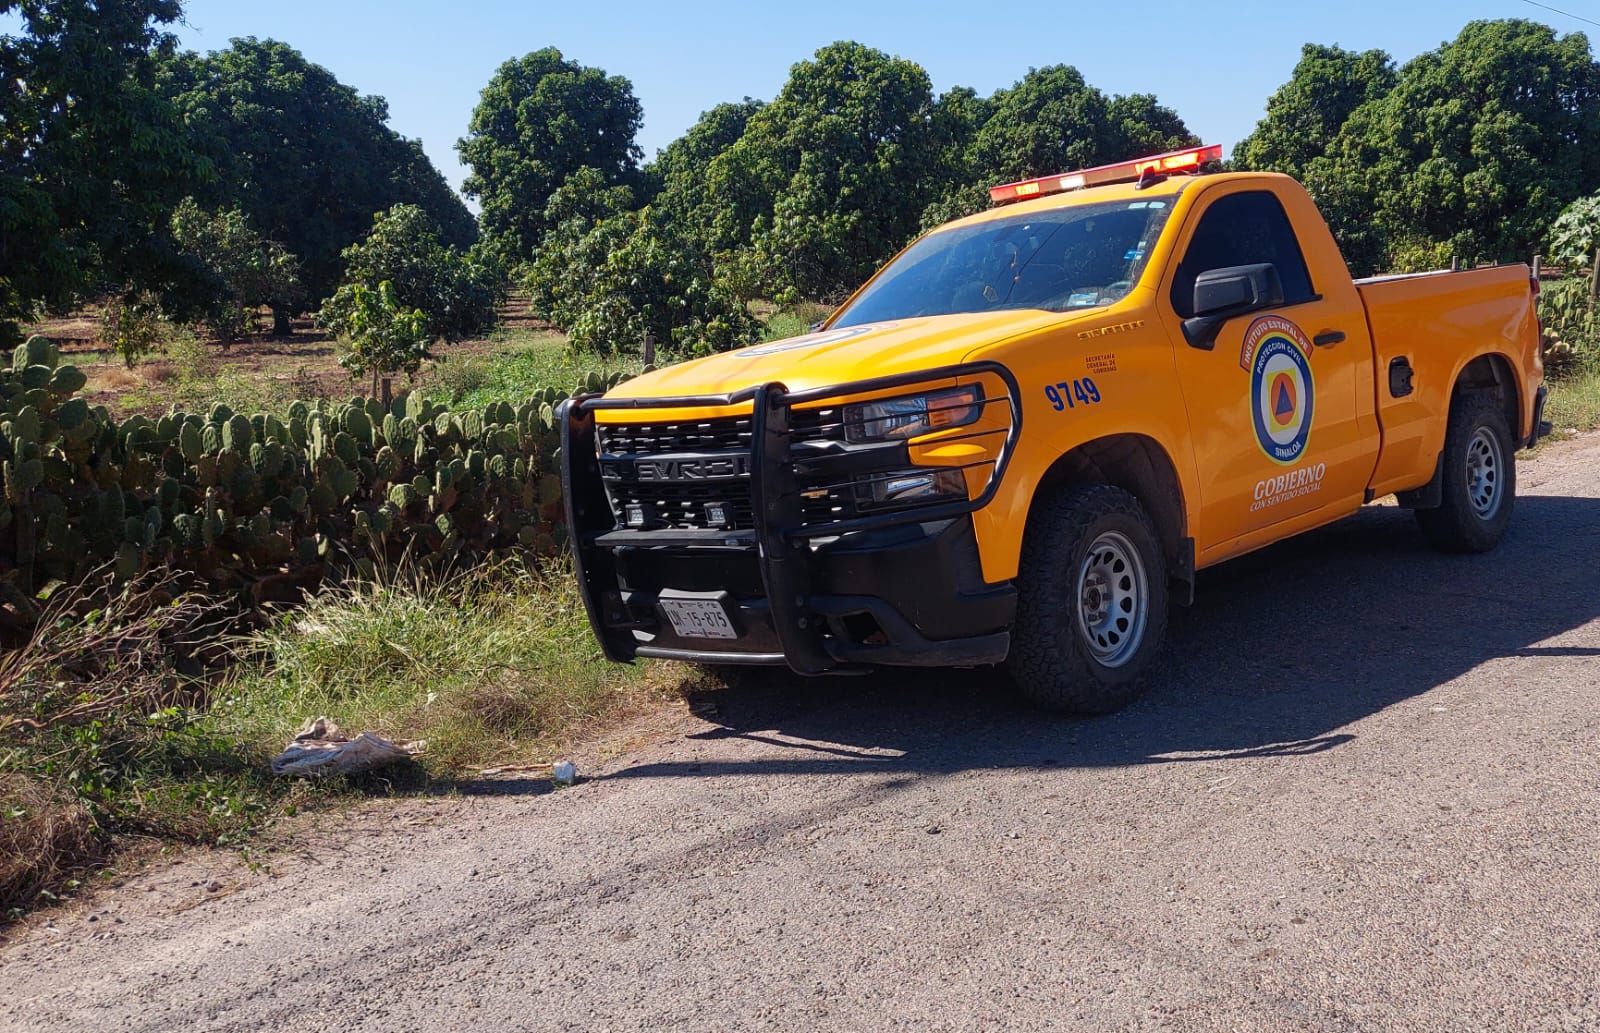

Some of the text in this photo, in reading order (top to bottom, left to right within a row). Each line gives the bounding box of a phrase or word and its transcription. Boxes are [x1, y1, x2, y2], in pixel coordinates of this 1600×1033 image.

[1244, 322, 1268, 363] INSTITUTO
[1267, 320, 1298, 340] ESTATAL
[1287, 345, 1302, 365] CIVIL
[1044, 377, 1101, 411] 9749
[1275, 441, 1302, 458] SINALOA
[1249, 482, 1321, 512] CON SENTIDO SOCIAL
[1253, 462, 1327, 500] GOBIERNO
